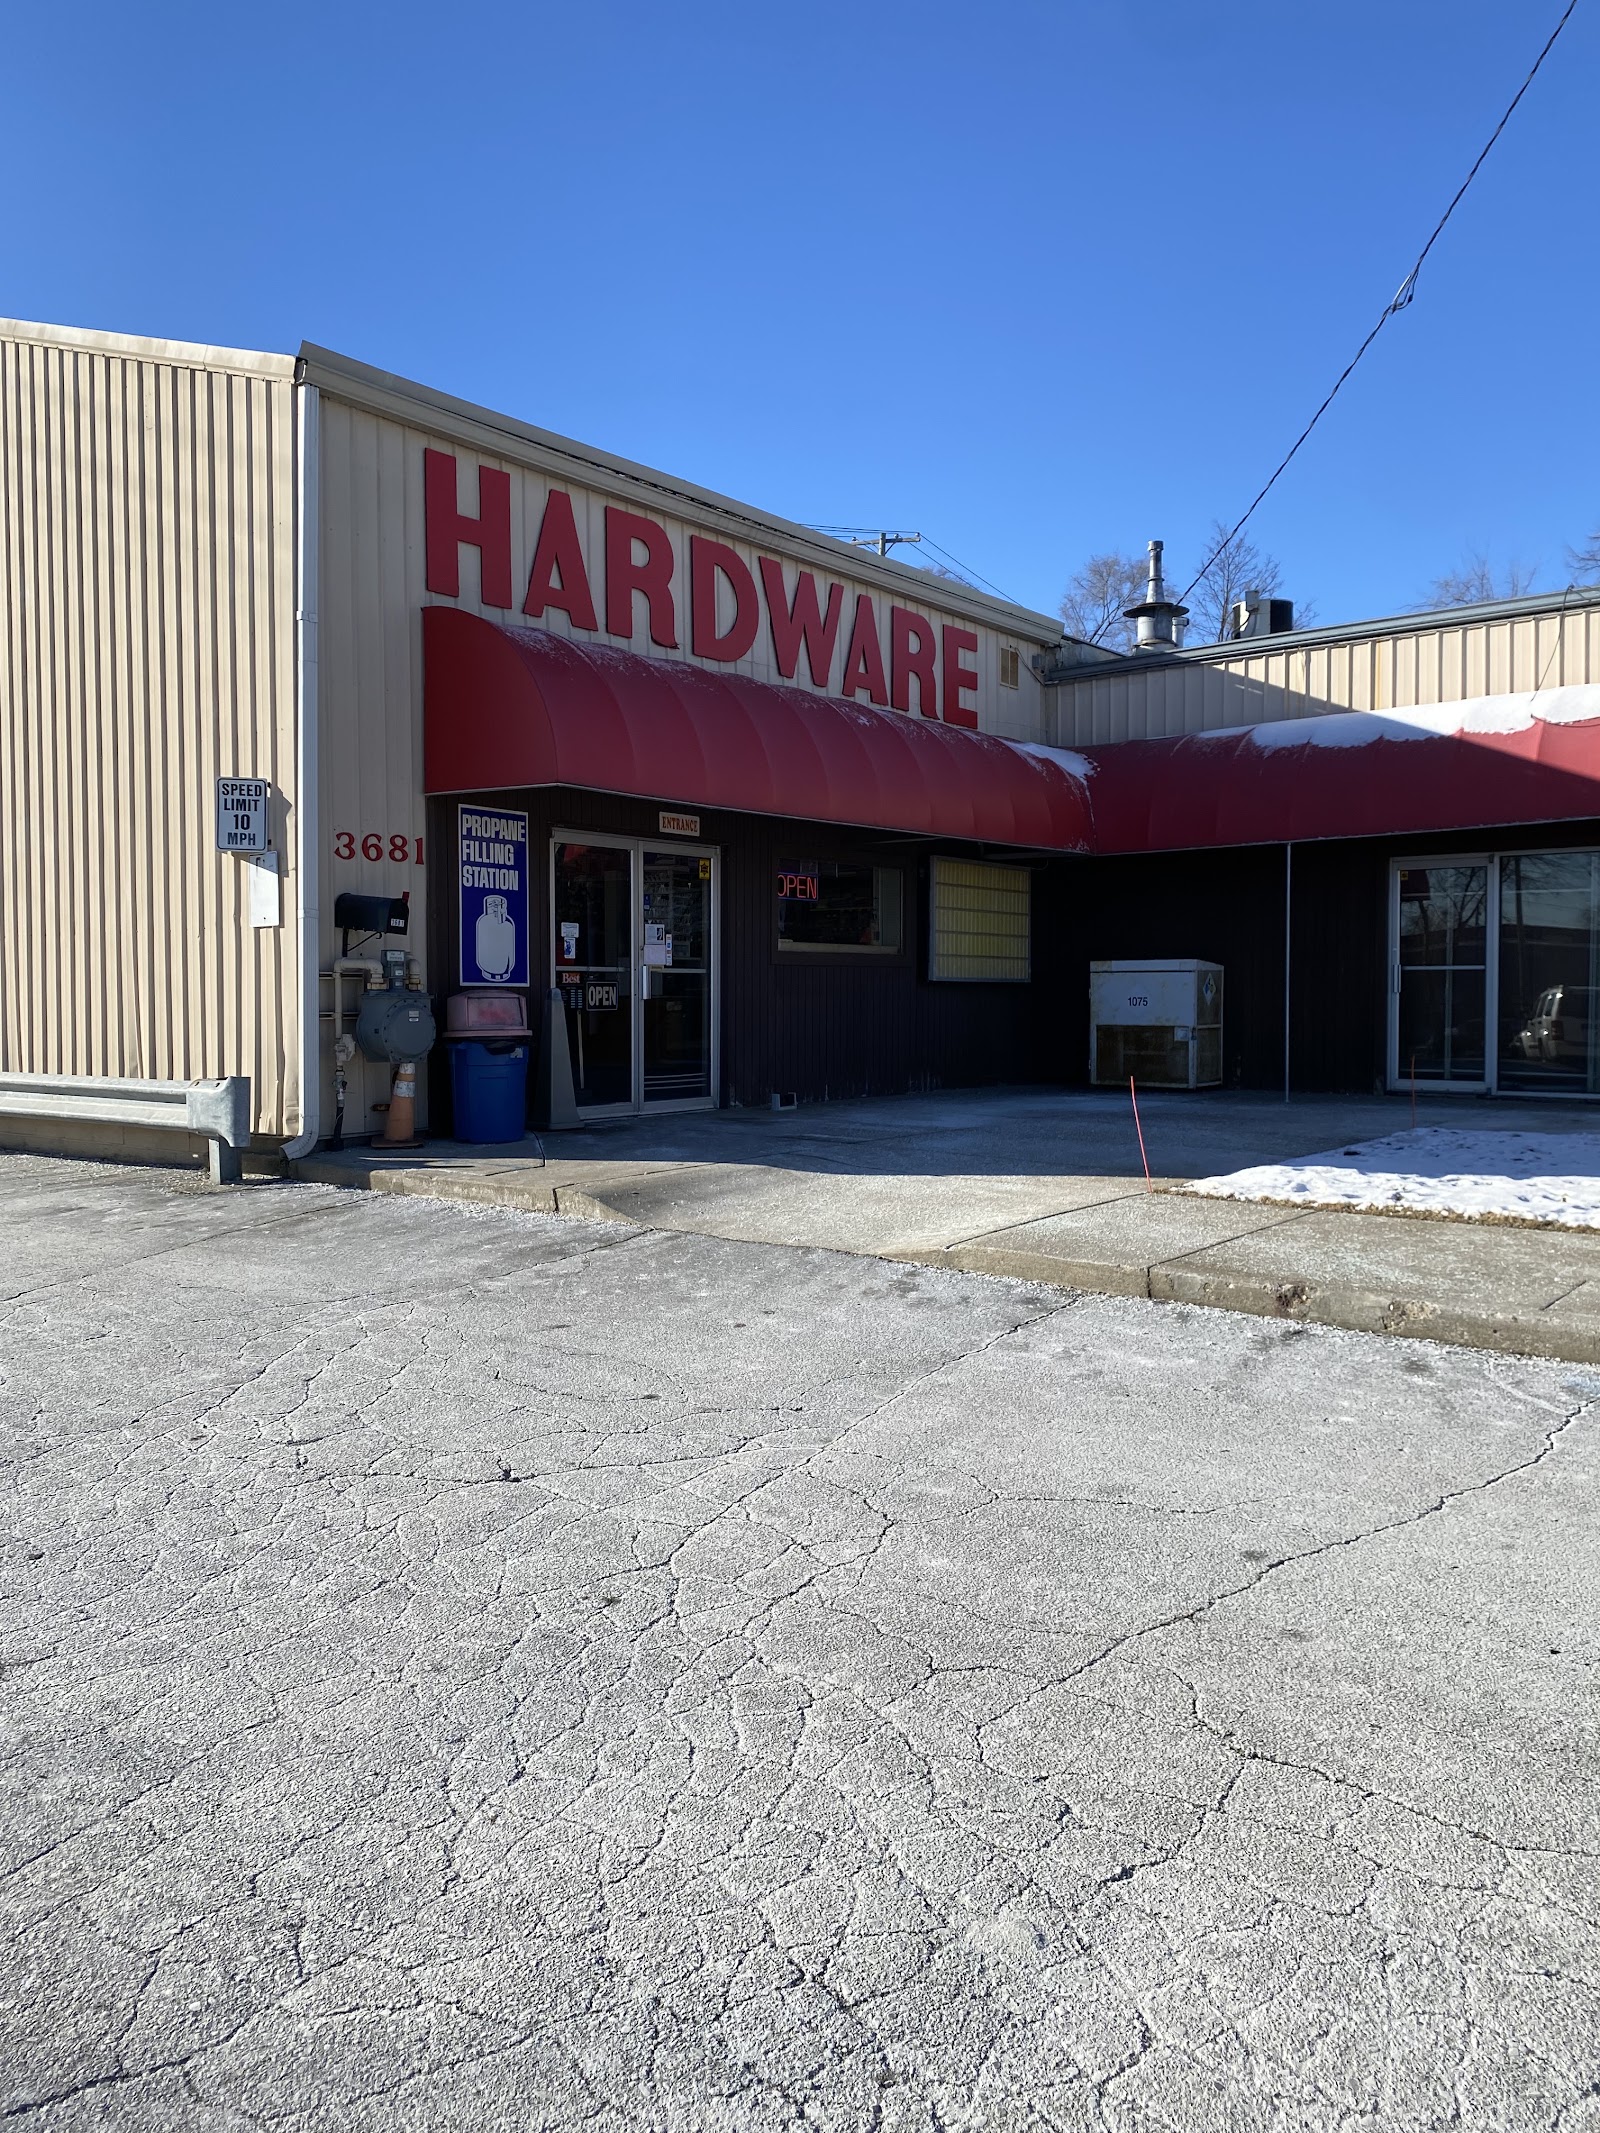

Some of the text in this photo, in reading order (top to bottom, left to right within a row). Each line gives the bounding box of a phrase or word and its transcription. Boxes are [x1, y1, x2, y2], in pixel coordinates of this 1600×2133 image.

[425, 447, 978, 729] HARDWARE
[221, 783, 262, 797] SPEED
[223, 798, 259, 812] LIMIT
[233, 814, 250, 831] 10
[462, 814, 526, 842] PROPANE
[662, 816, 698, 832] ENTRANCE
[227, 832, 256, 846] MPH
[333, 831, 425, 865] 3681
[462, 839, 514, 866] FILLING
[462, 865, 519, 891] STATION
[777, 874, 817, 899] OPEN
[562, 972, 581, 984] Best
[588, 985, 617, 1006] OPEN
[1127, 996, 1148, 1007] 1075
